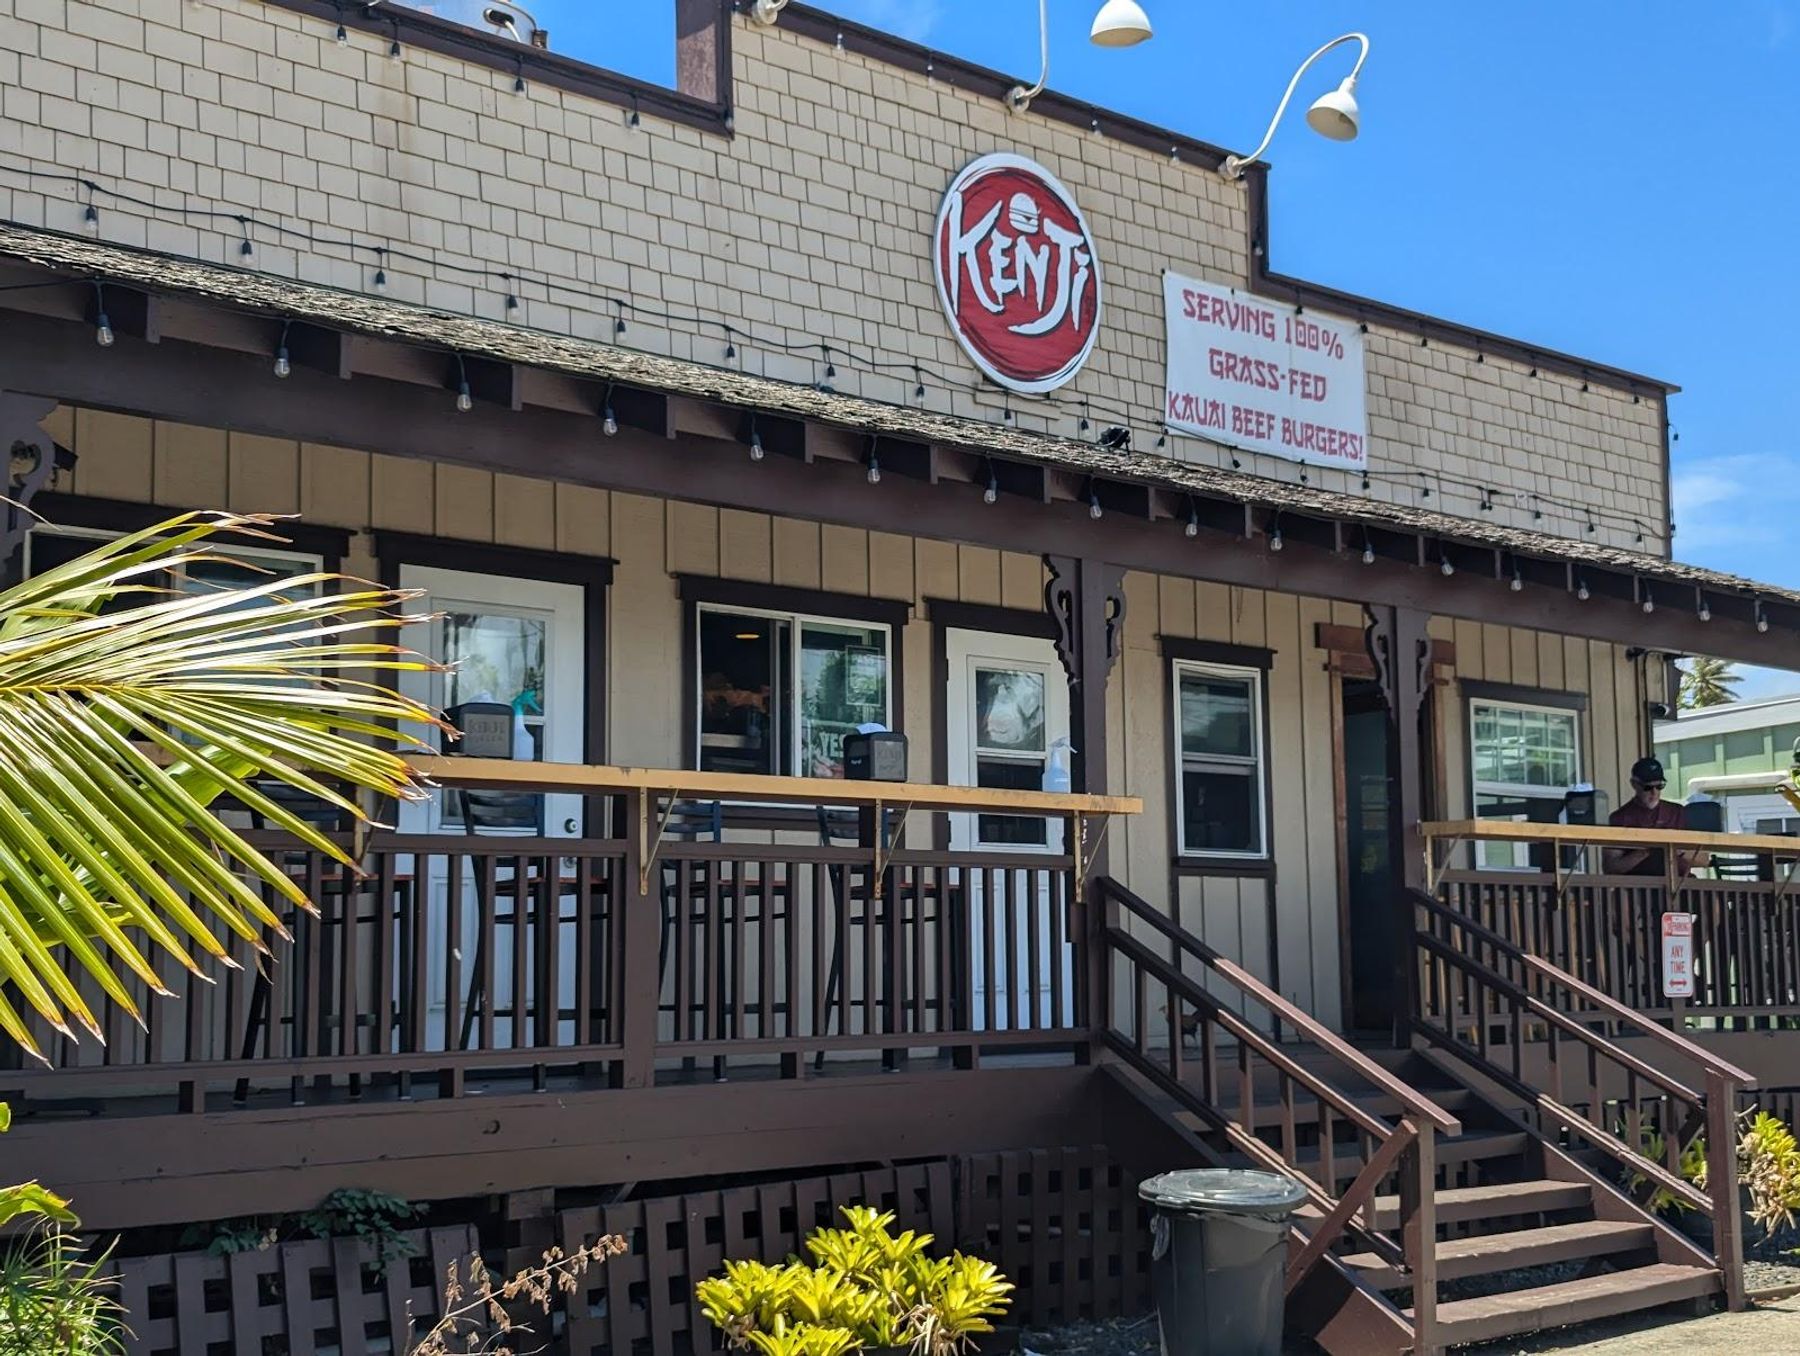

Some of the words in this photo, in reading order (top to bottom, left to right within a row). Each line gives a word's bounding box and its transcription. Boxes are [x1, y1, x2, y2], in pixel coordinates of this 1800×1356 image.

[1182, 289, 1275, 342] SERVING
[1285, 317, 1344, 360] 100%
[1209, 348, 1326, 402] GRASS-FED
[1168, 391, 1226, 429] KAUAI
[1232, 405, 1275, 440] BEEF
[1282, 417, 1364, 462] BURGERS!
[1670, 960, 1686, 974] TIME
[1671, 945, 1684, 958] ANY
